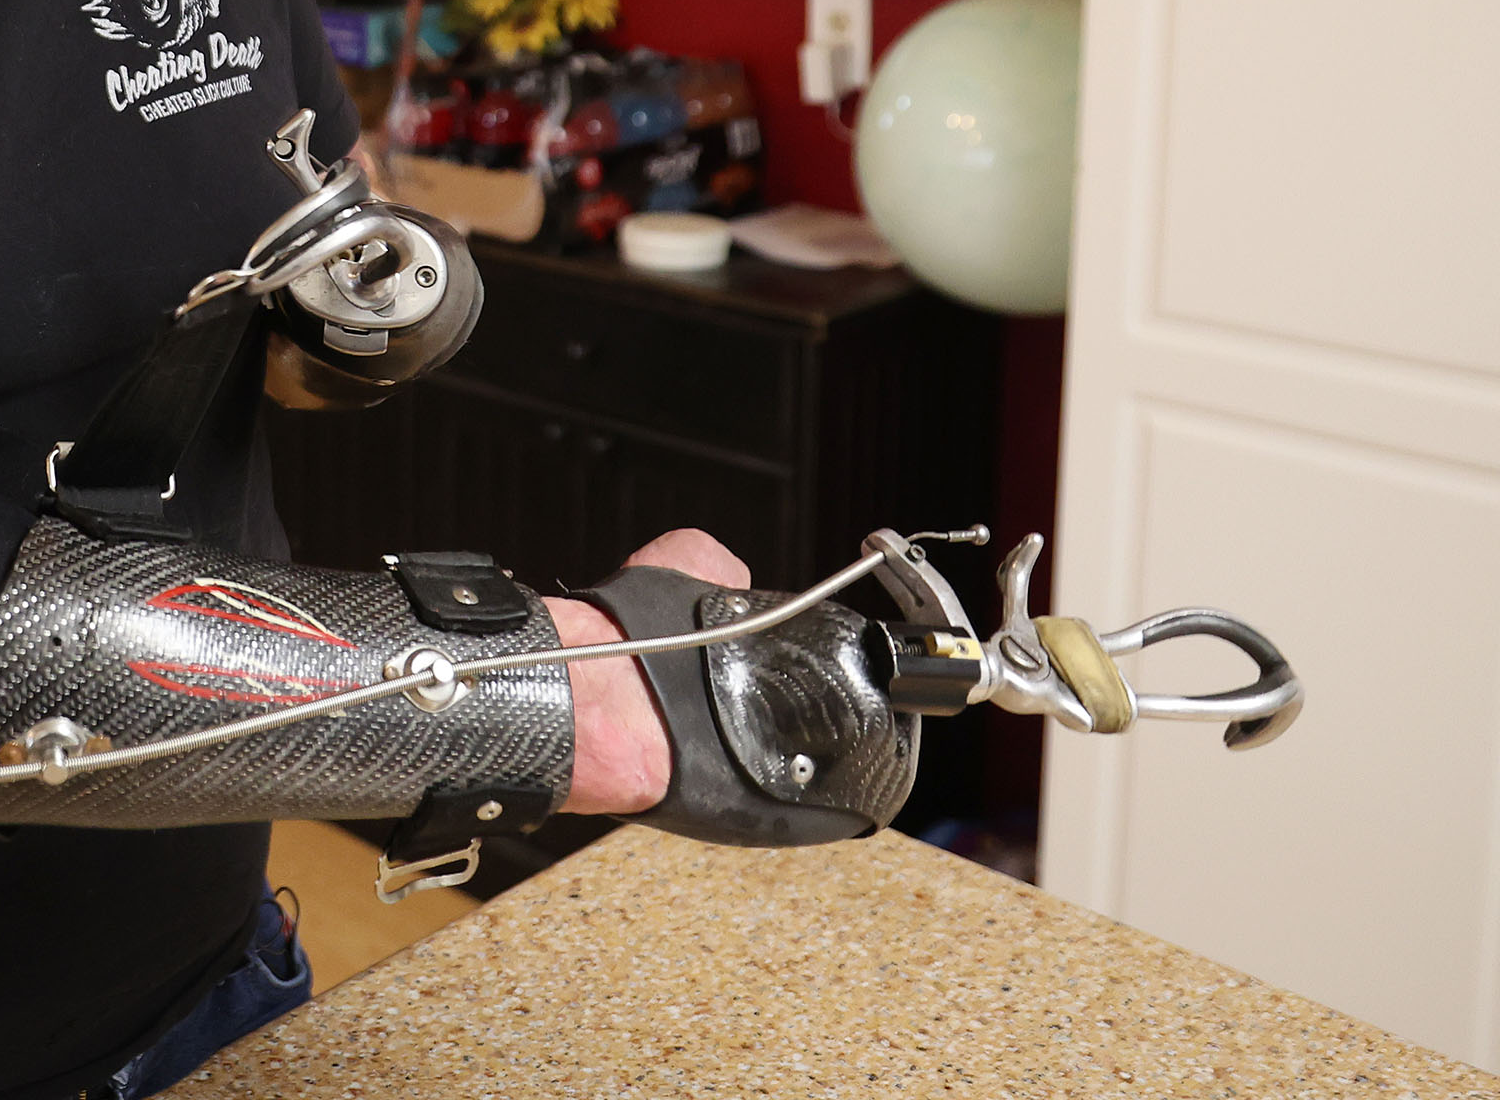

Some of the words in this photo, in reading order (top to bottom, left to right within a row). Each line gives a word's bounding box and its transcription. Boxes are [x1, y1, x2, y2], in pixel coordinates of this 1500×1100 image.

[106, 49, 207, 112] Cheating
[208, 31, 264, 70] Death
[139, 91, 196, 123] CHEATER
[192, 82, 220, 106] SLICK
[219, 73, 252, 99] CULTURE
